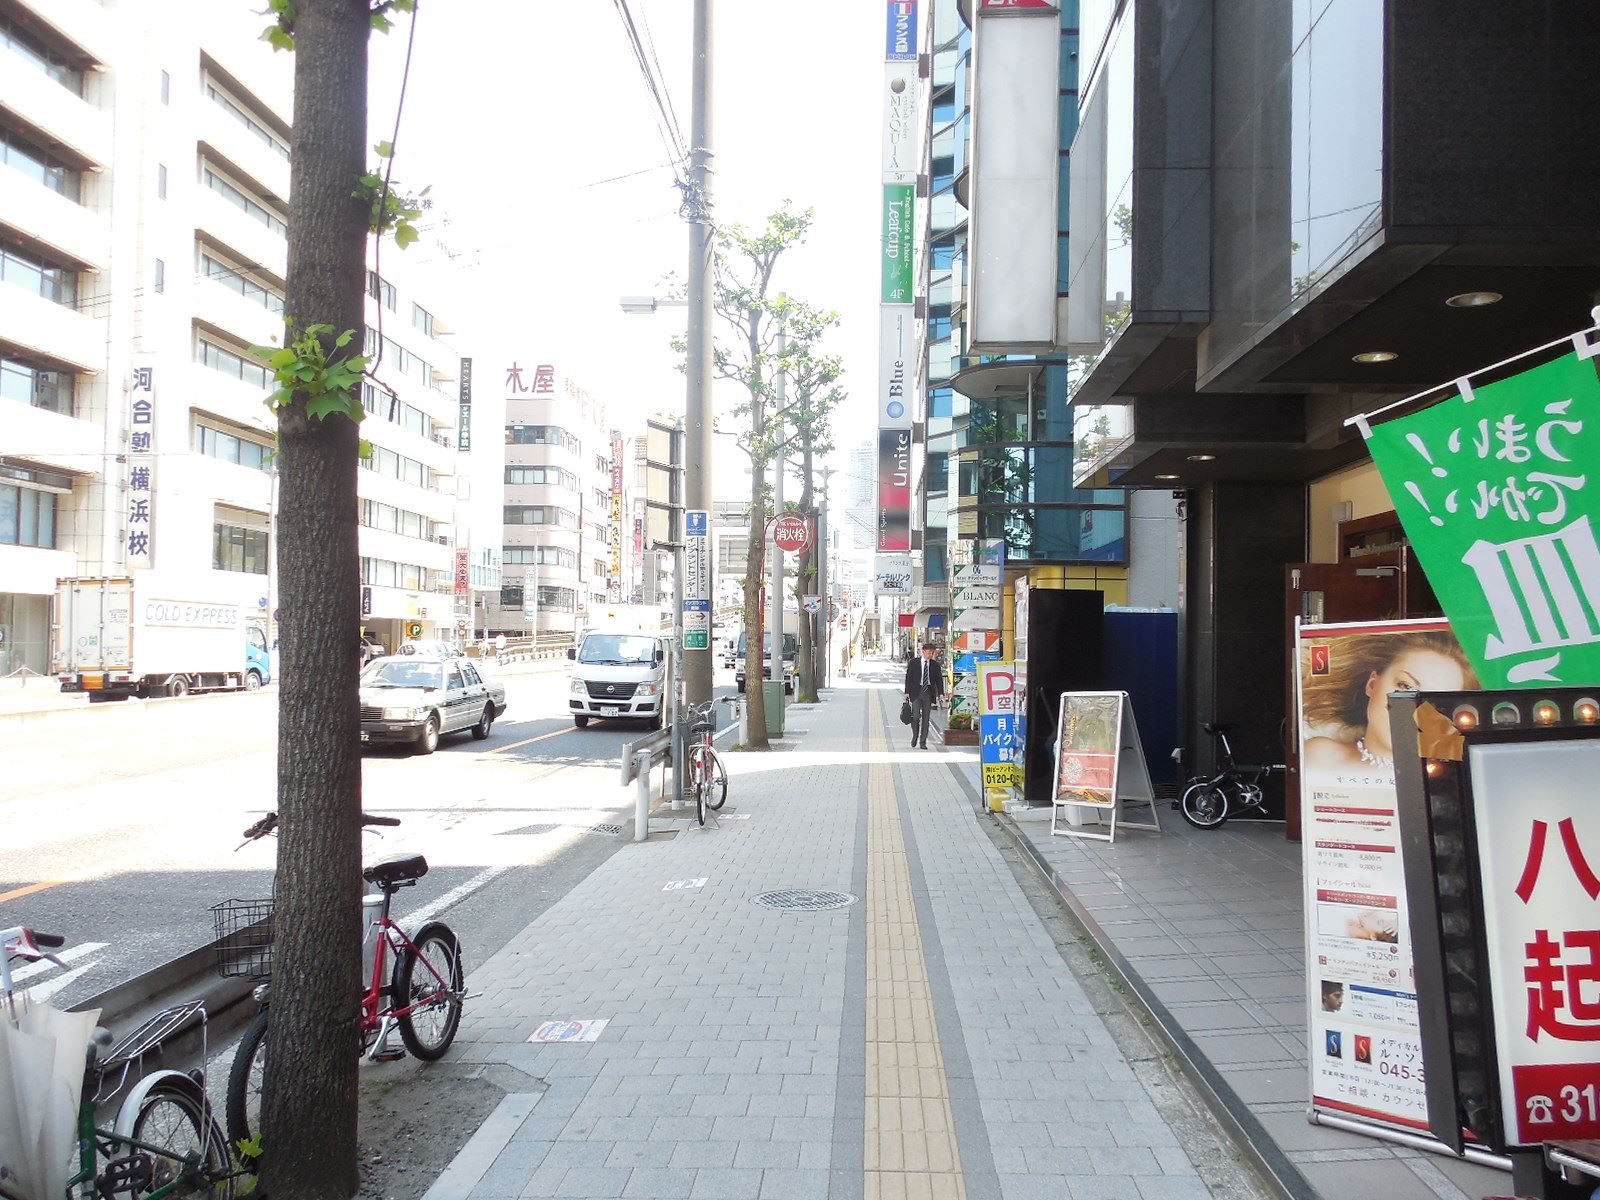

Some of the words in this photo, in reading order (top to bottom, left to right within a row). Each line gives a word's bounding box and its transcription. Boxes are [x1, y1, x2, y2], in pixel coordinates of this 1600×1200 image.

[886, 200, 903, 259] Leafcup
[889, 360, 904, 398] Blue
[132, 367, 152, 453] 河合塾
[893, 433, 908, 487] Unite
[128, 466, 150, 557] 横浜校
[776, 527, 805, 541] 消火栓
[876, 573, 911, 581] メーテルリンク
[145, 604, 181, 622] COLD
[986, 672, 1014, 711] P
[997, 697, 1012, 710] 空
[983, 733, 1013, 746] バイク
